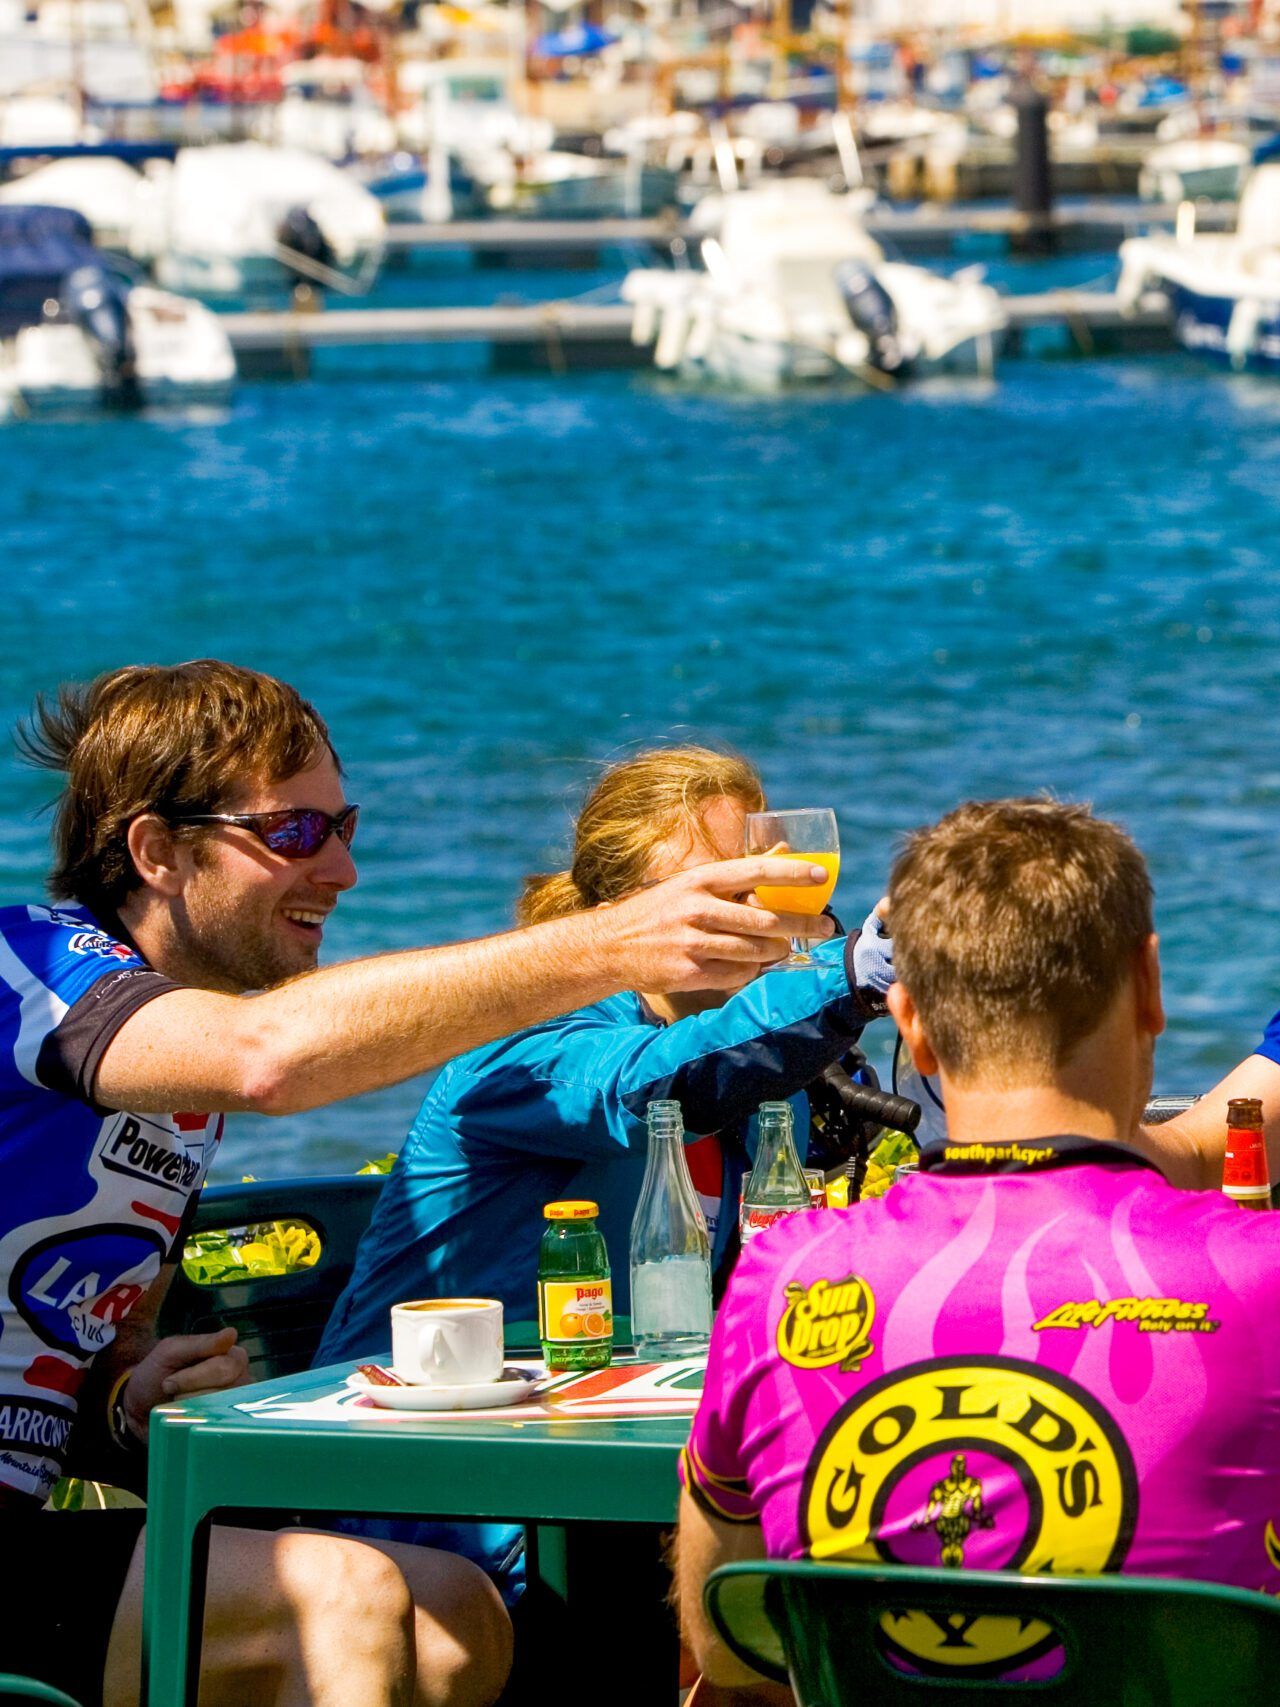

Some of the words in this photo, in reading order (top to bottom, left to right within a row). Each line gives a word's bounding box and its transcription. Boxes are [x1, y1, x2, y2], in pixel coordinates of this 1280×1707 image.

[575, 1287, 603, 1302] pago
[795, 1279, 860, 1321] Sun
[73, 1314, 105, 1344] club
[789, 1313, 861, 1356] Drop
[825, 1384, 1104, 1530] GOLD'S
